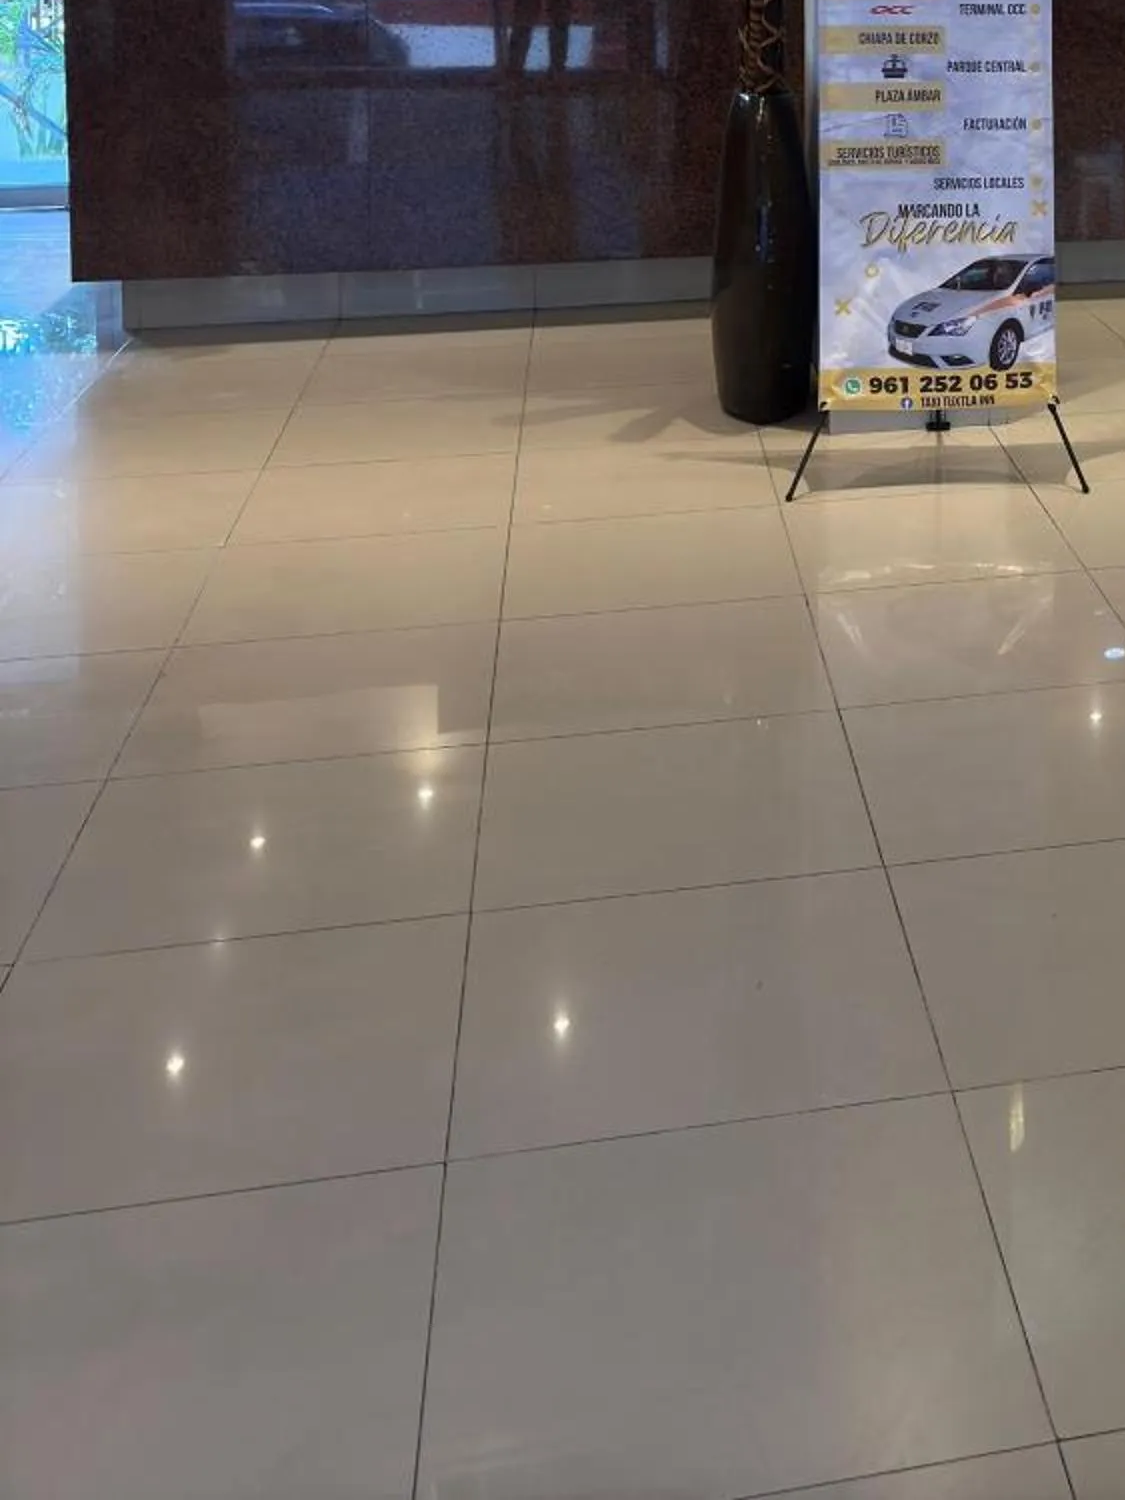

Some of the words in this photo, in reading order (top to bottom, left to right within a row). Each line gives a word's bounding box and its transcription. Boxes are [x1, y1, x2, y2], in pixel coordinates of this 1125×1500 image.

[960, 3, 1005, 16] TERMINAL
[895, 32, 907, 45] DE
[909, 31, 940, 45] CORZO
[947, 60, 983, 73] PARQUE
[985, 60, 1026, 73] CENTRAL
[875, 89, 905, 103] PLAZA
[963, 116, 1027, 131] FACTURACIÓN
[837, 146, 885, 159] SERVICIOS
[934, 178, 982, 191] SERVICIOS
[984, 177, 1025, 190] LOCALES
[898, 203, 963, 218] MARCANDO
[965, 203, 981, 217] LA
[859, 211, 1019, 253] Diferencia
[869, 375, 909, 394] 961
[919, 375, 963, 393] 252
[969, 373, 998, 391] 06
[1005, 371, 1033, 389] 53
